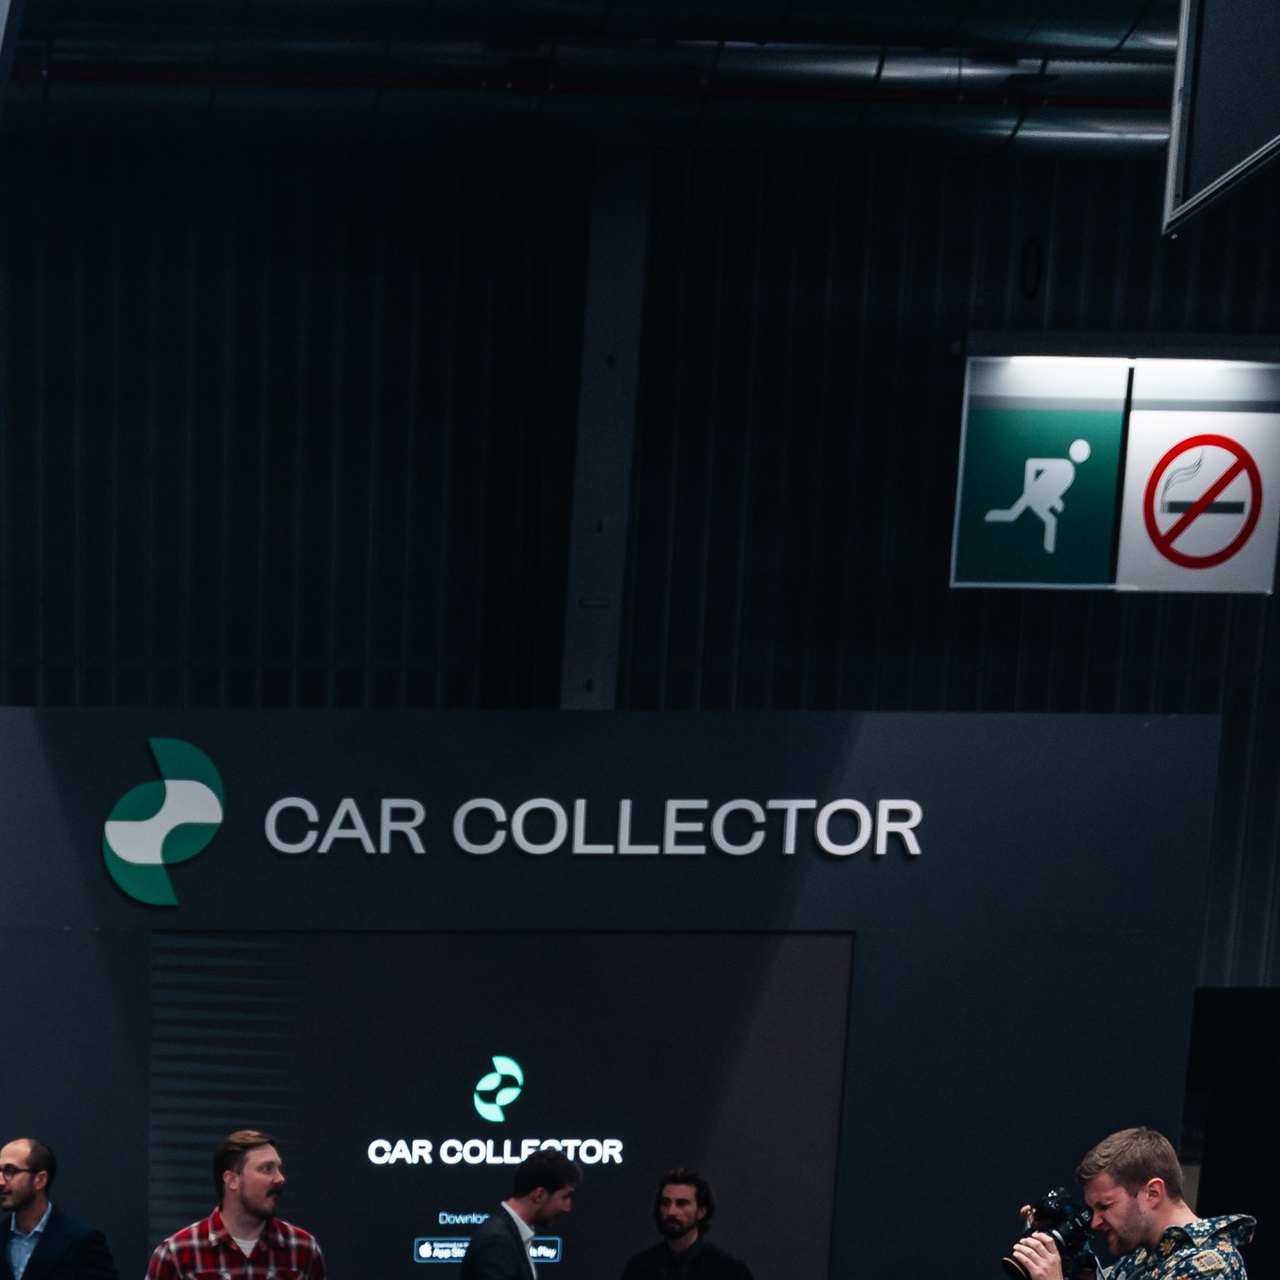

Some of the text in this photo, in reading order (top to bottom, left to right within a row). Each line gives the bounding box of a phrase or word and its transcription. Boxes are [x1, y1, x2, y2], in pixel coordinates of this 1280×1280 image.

[264, 796, 924, 856] CAR COLLECTOR
[367, 1138, 432, 1165] CAR
[438, 1211, 490, 1225] Downlo
